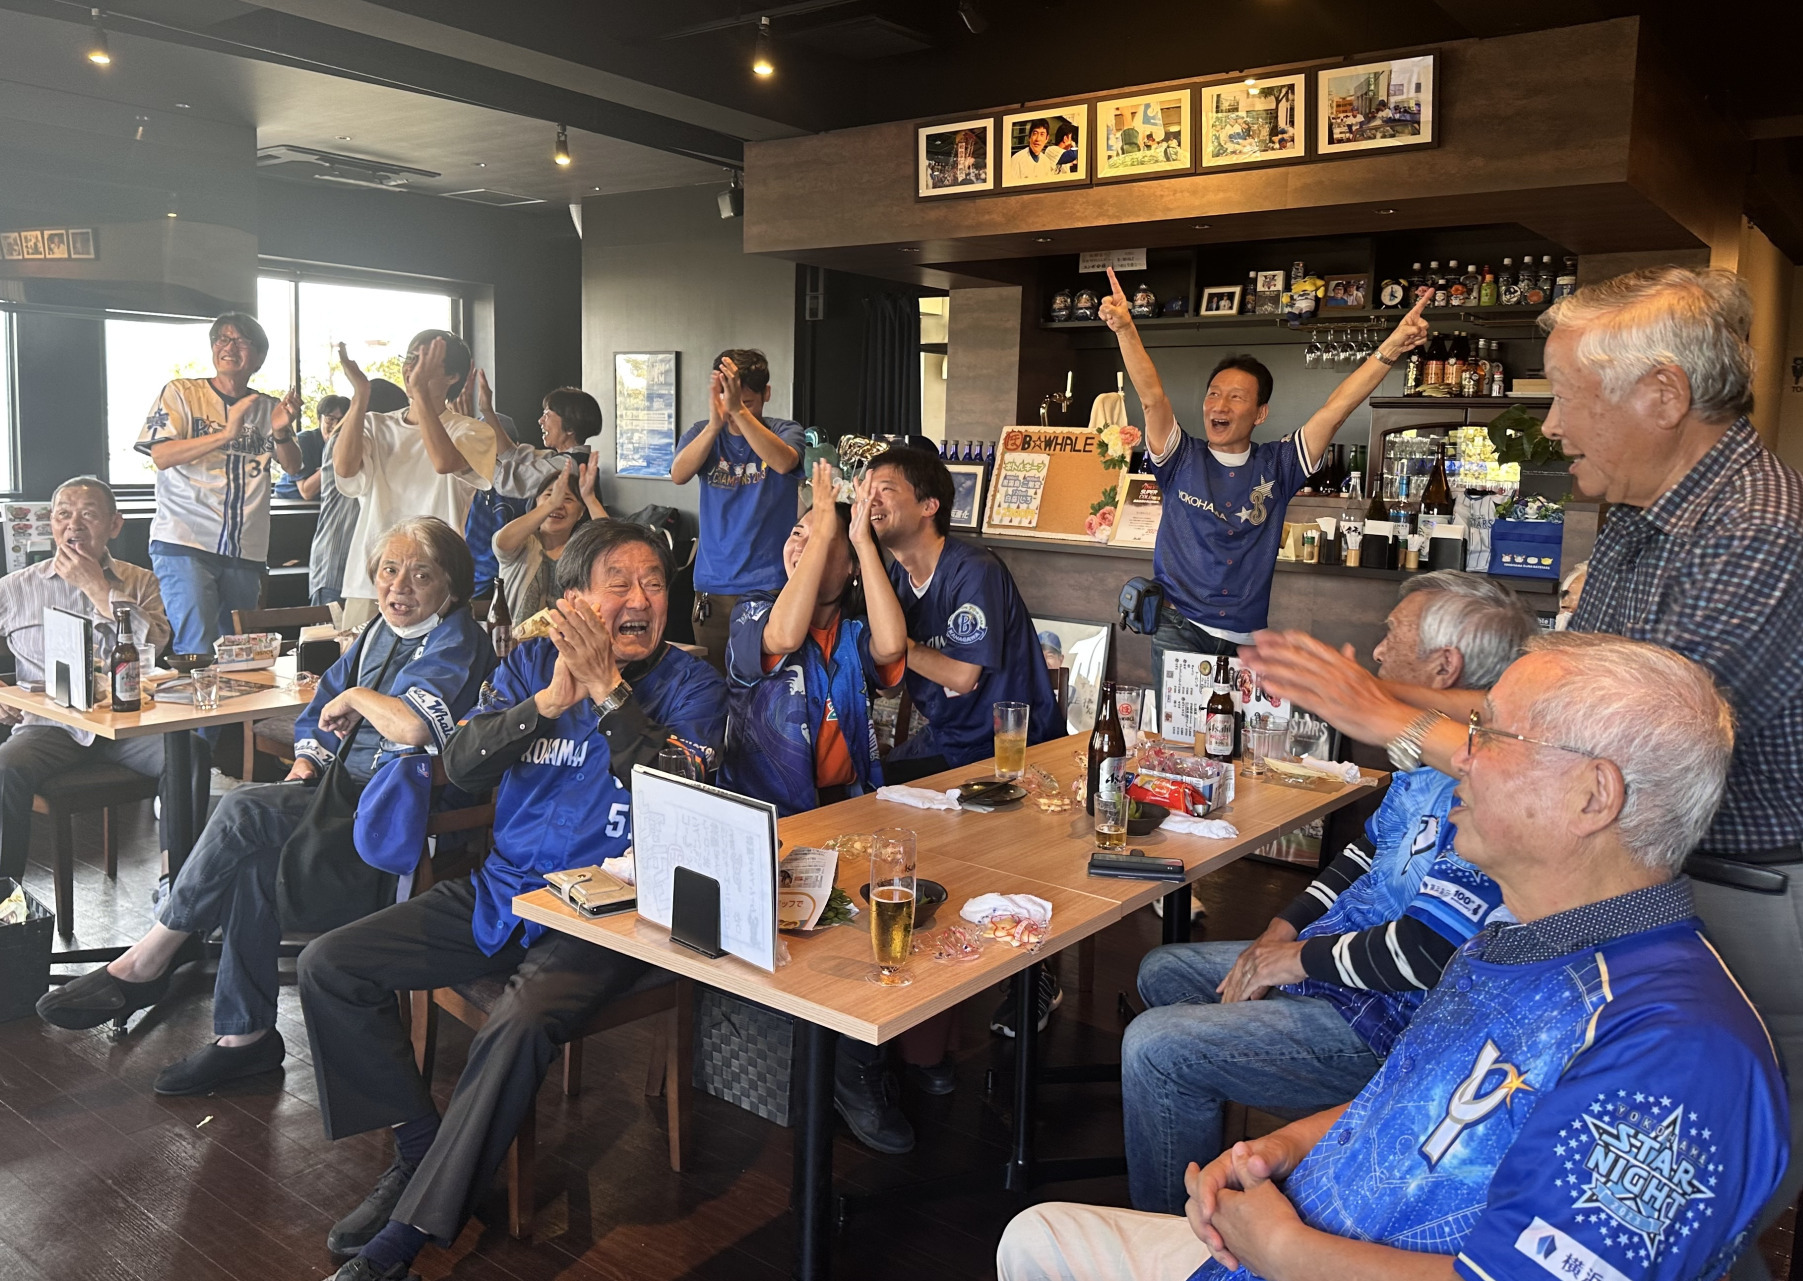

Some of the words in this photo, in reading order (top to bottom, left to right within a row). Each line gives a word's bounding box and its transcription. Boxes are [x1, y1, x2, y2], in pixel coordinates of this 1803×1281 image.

[605, 803, 632, 840] 5
[1600, 1121, 1697, 1194] STAR
[1616, 1103, 1708, 1167] YOKOHAMA
[1583, 1143, 1687, 1221] NIGHT
